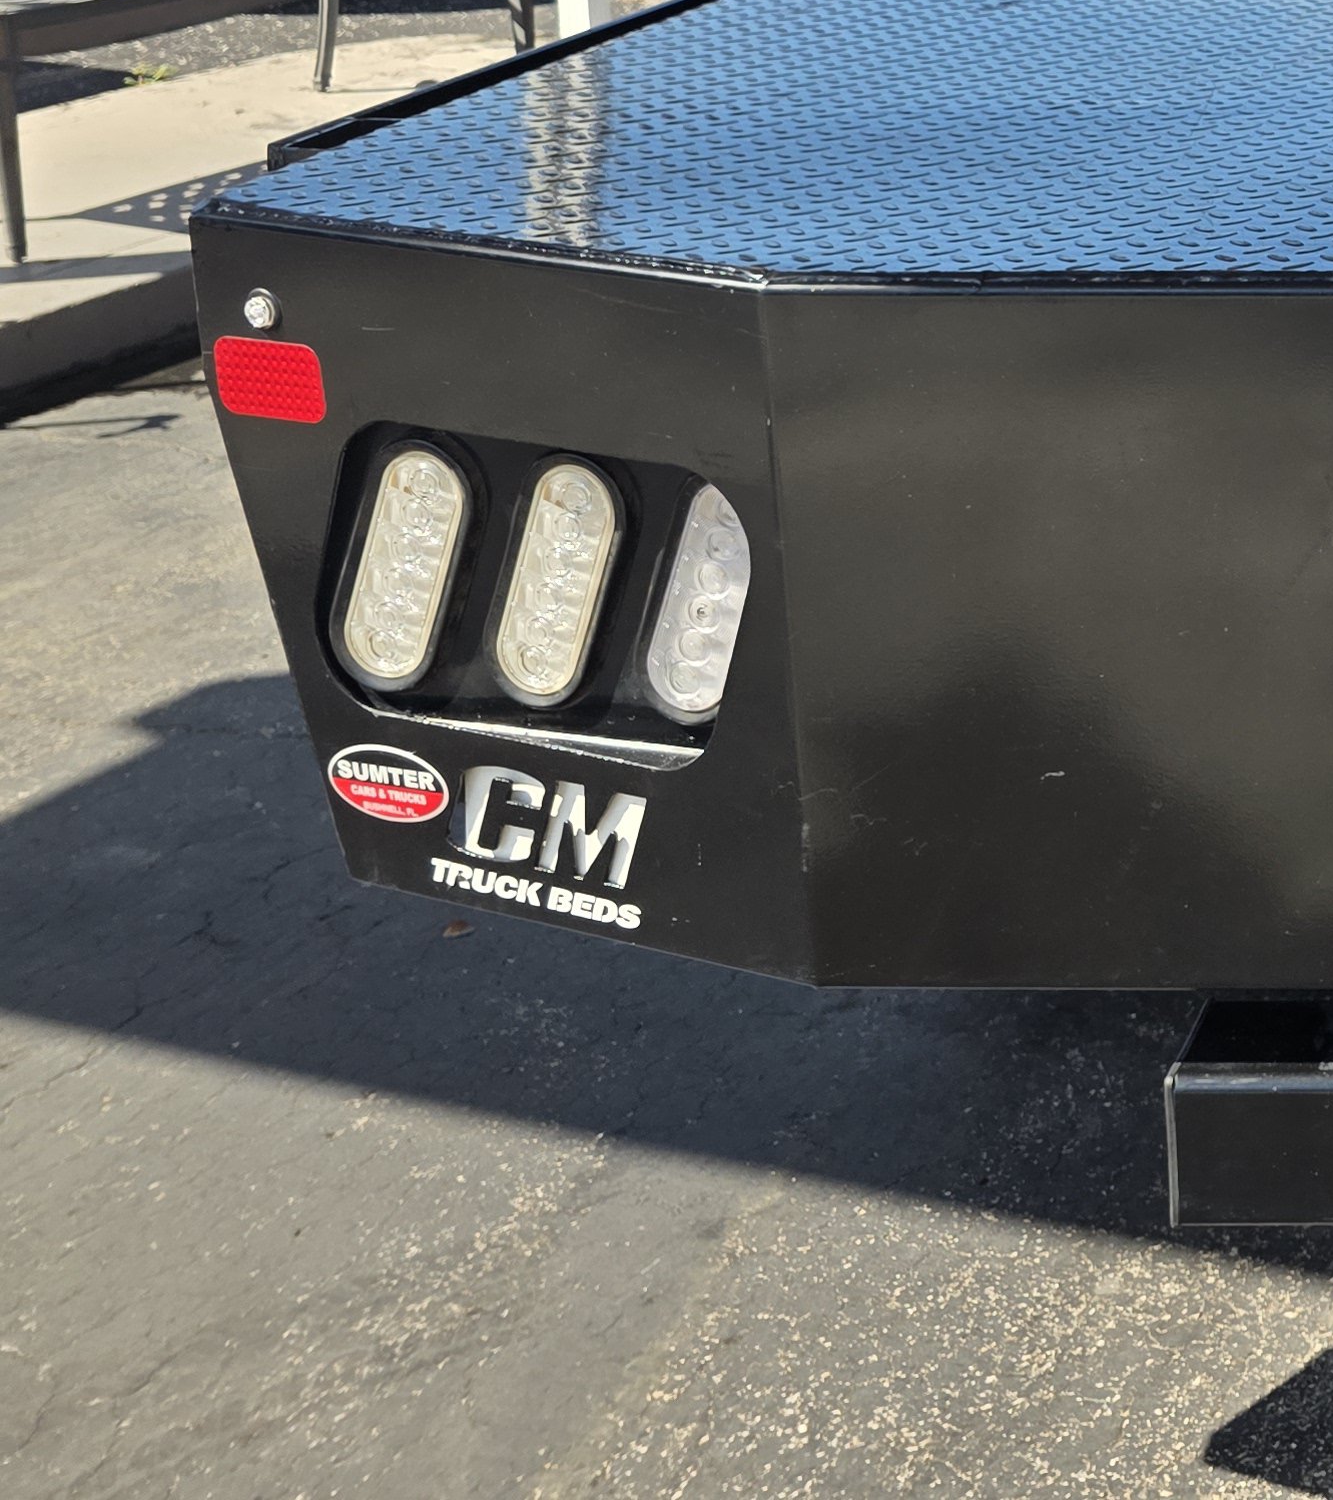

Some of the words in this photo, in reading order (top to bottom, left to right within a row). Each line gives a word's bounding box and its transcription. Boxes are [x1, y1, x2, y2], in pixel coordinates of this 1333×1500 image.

[337, 759, 437, 792] SUMTER
[350, 784, 377, 798] CARS
[378, 788, 387, 799] &
[387, 790, 427, 806] TRUCKS
[447, 765, 648, 890] CM
[430, 857, 543, 908] TRUCK
[547, 886, 642, 930] BEDS
